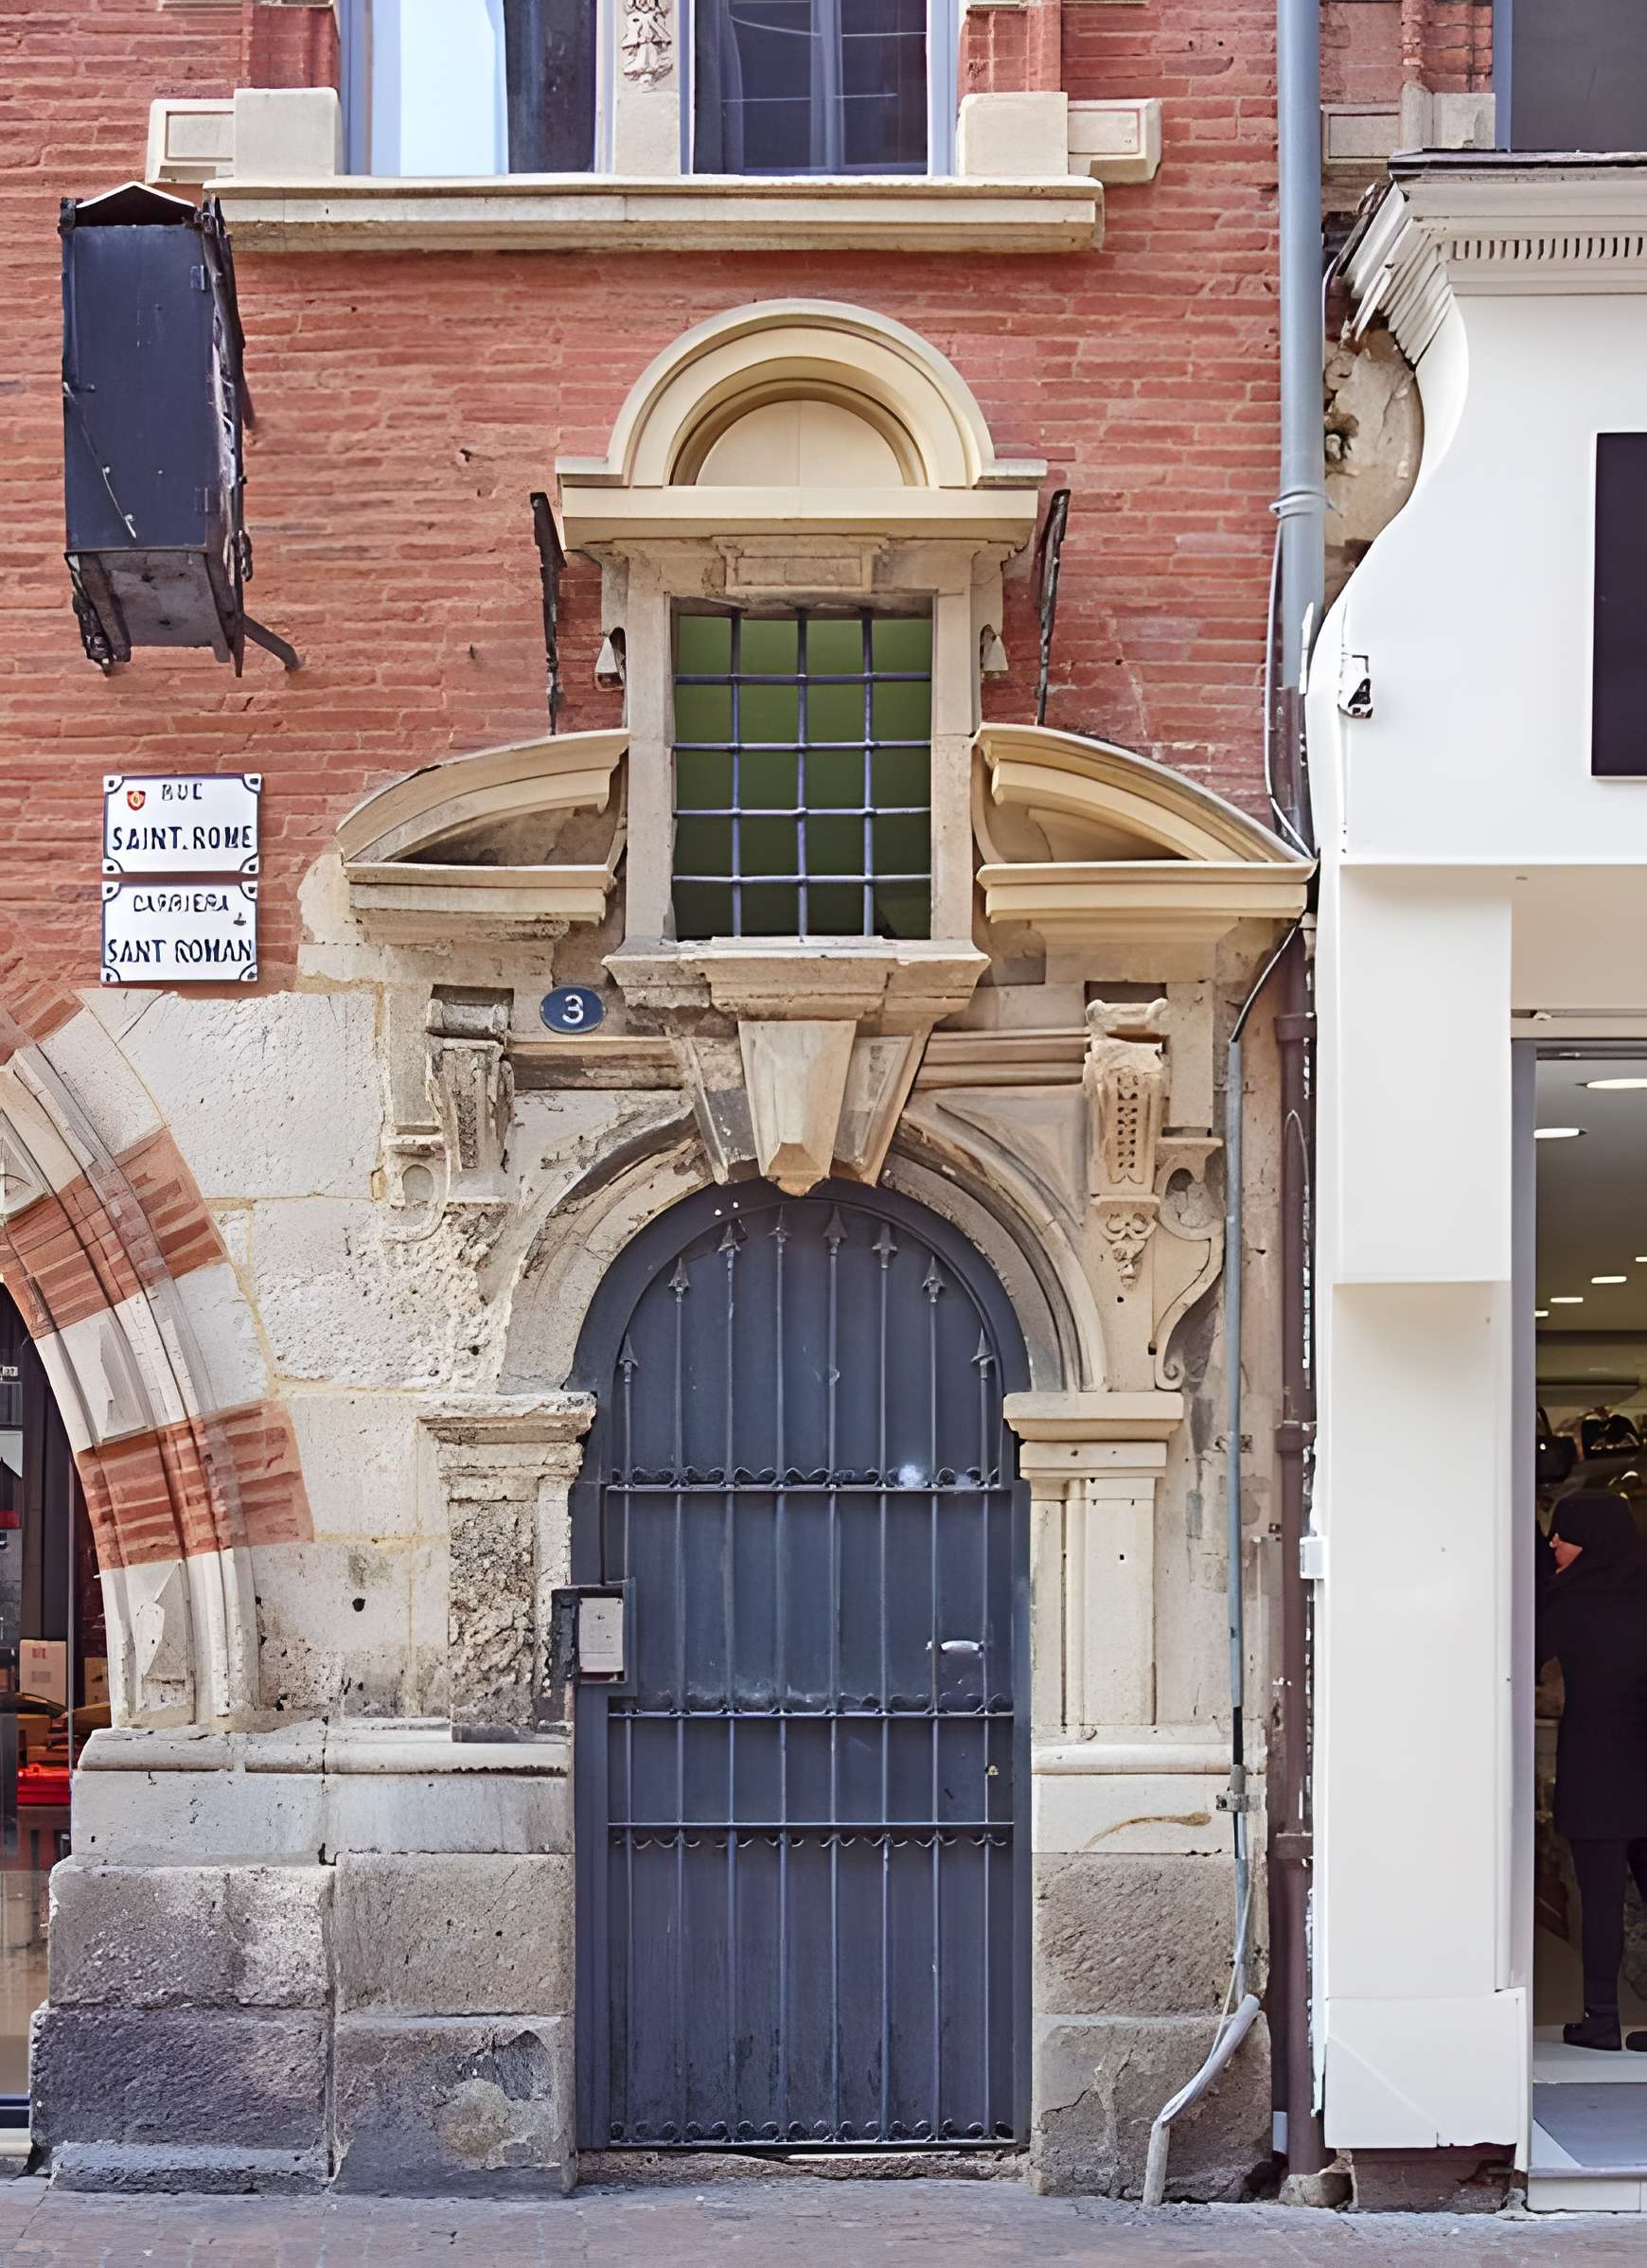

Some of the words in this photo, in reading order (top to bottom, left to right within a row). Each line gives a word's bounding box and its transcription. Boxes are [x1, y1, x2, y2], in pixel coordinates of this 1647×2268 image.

[107, 939, 168, 964] SANT
[175, 939, 252, 964] ROMAN
[561, 994, 584, 1024] 3
